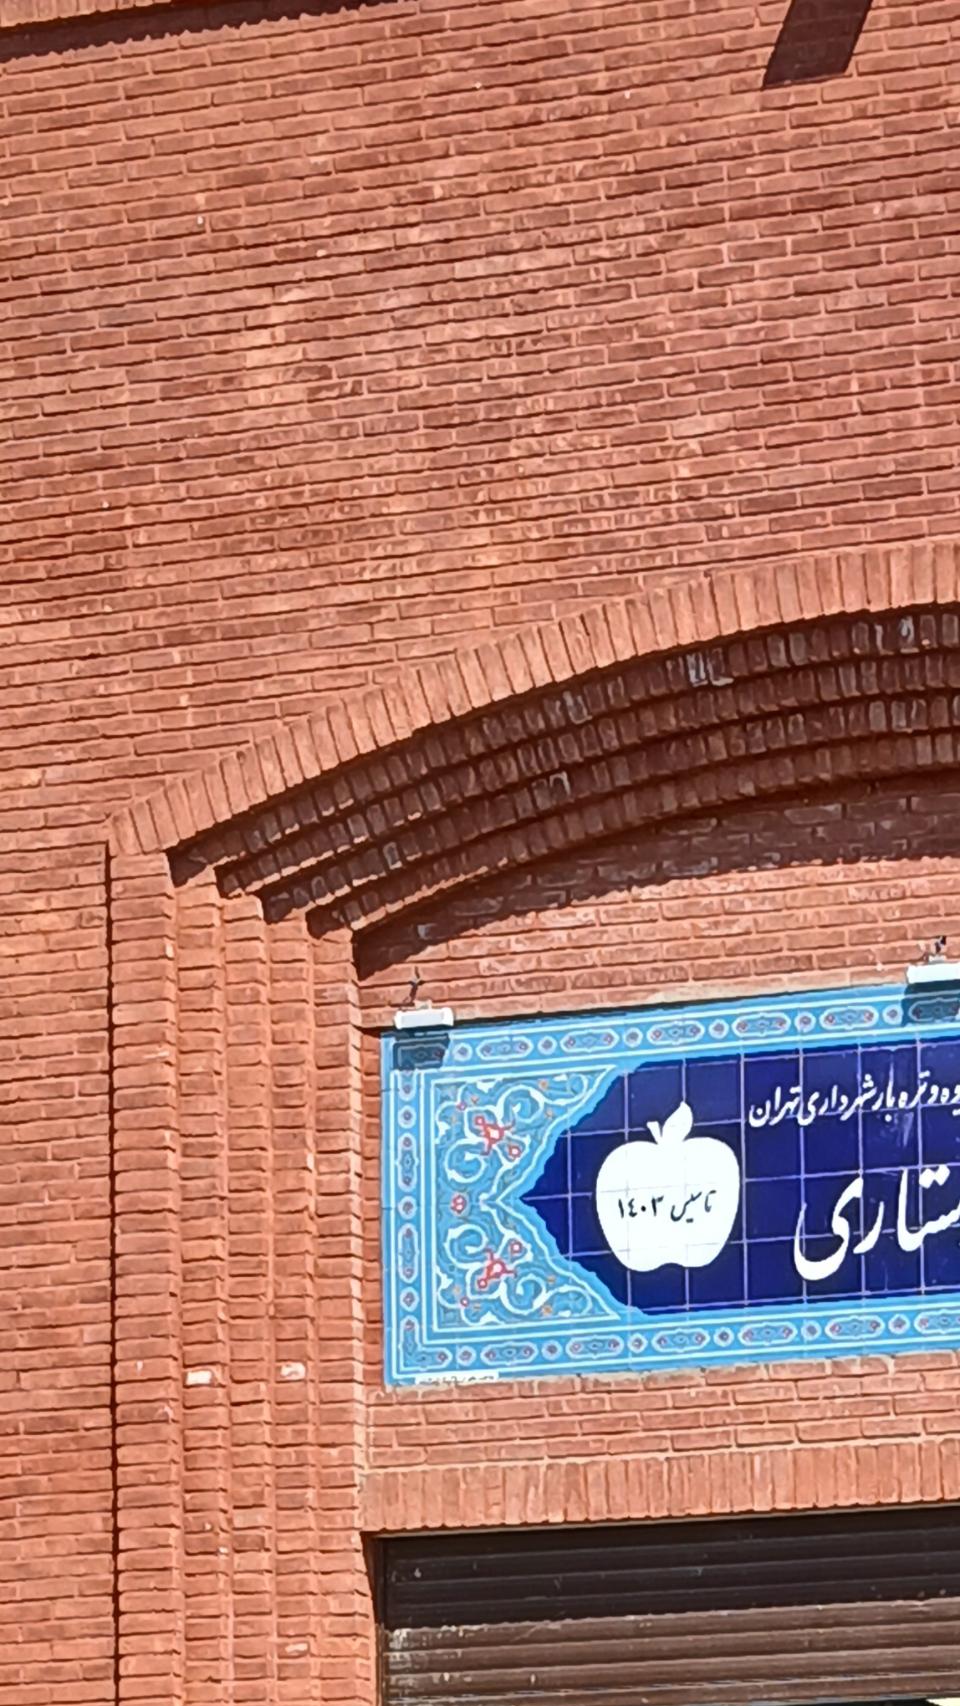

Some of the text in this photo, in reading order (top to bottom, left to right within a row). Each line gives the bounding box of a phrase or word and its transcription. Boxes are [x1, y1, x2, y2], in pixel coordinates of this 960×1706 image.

[748, 1086, 802, 1128] تهران
[797, 1073, 878, 1126] شهرداری
[871, 1062, 895, 1122] بار
[898, 1070, 931, 1110] تره
[928, 1084, 939, 1104] و
